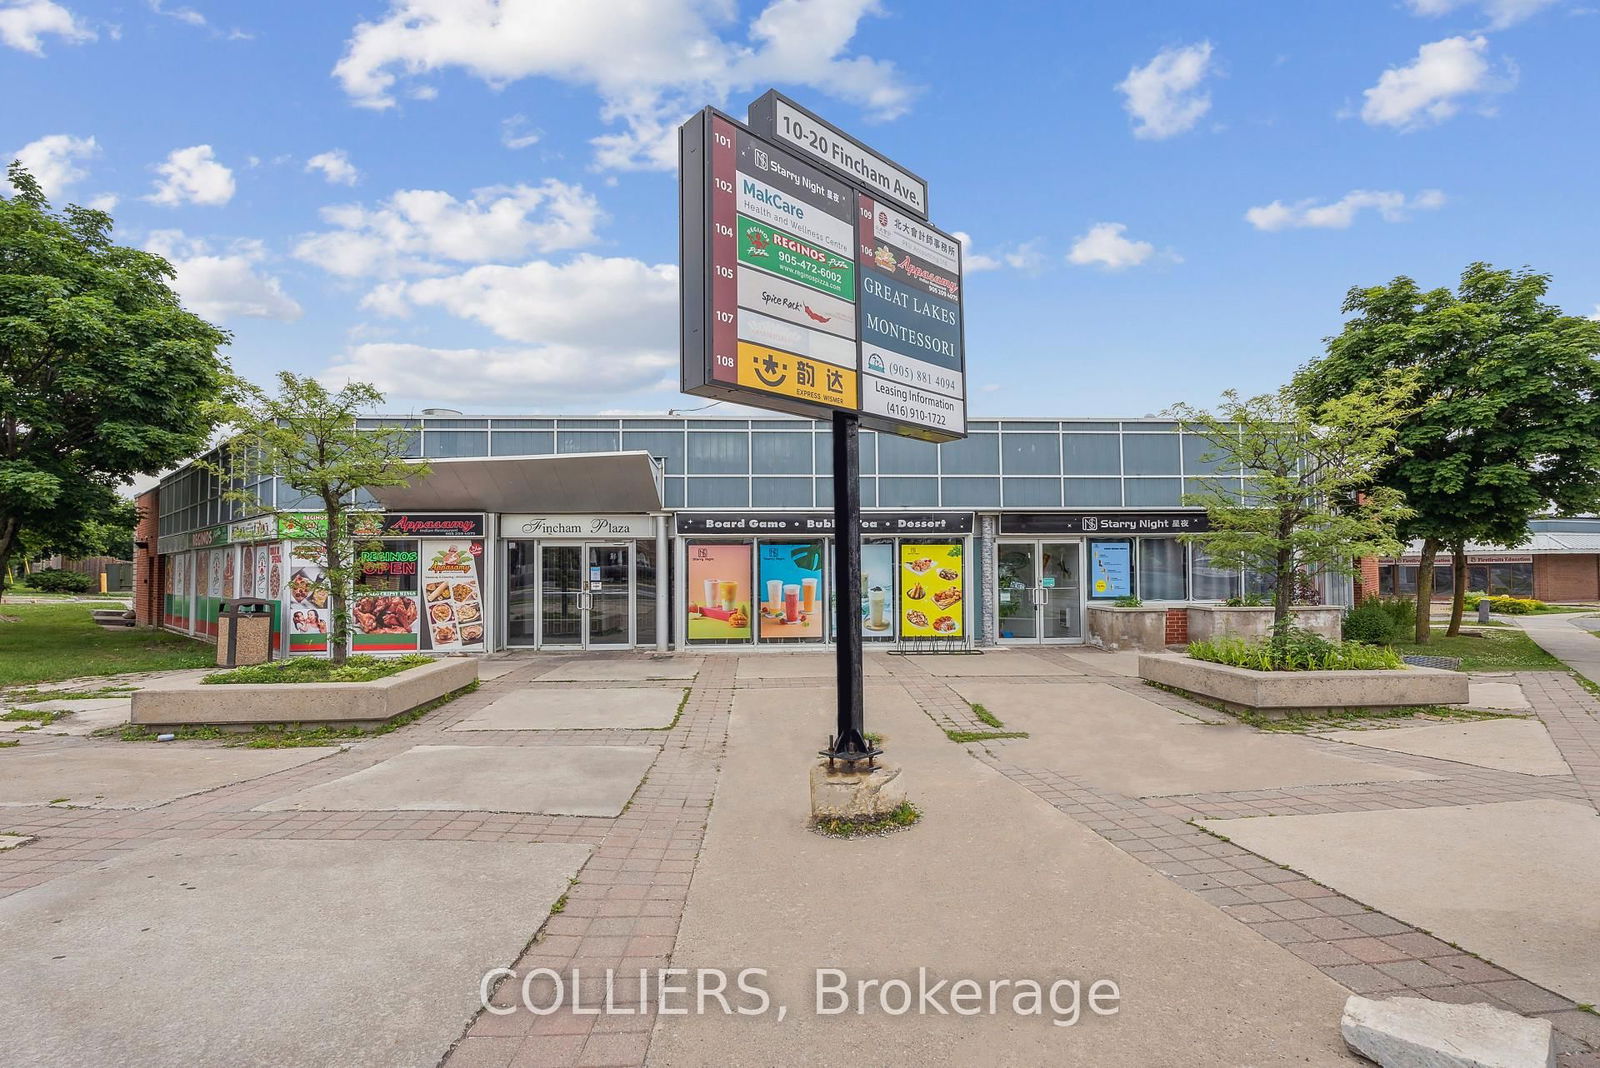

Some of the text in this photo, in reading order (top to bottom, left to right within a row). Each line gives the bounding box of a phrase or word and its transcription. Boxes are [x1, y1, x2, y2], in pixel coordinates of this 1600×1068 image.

[714, 132, 731, 149] 101
[783, 116, 920, 206] 10-20 Fincham Ave.
[715, 178, 733, 194] 102
[770, 160, 800, 185] Starry
[802, 175, 826, 198] Night
[743, 179, 804, 220] MakCare
[860, 207, 872, 220] 109
[715, 223, 733, 238] 104
[744, 200, 848, 252] Health and Wellness Centre
[773, 233, 826, 262] REGINOS
[861, 244, 873, 257] 106
[715, 265, 733, 279] 105
[779, 251, 842, 284] 905-472-6002
[898, 255, 958, 293] Appasamy
[779, 264, 841, 291] www.reginospizza.com
[761, 291, 781, 306] Spice
[864, 277, 908, 308] GREAT
[913, 297, 956, 326] LAKES
[716, 311, 733, 324] 107
[866, 313, 955, 357] MONTESSORI
[716, 355, 734, 368] 108
[889, 363, 955, 389] (905) 881 4094
[796, 389, 821, 400] EXPRESS
[875, 381, 954, 411] Leasing Information
[886, 402, 946, 426] (416) 910-1722
[391, 516, 476, 532] Appasamy
[522, 518, 630, 534] Fincham Plaza
[705, 519, 946, 528] Board Game Bub ea Dessert
[1100, 519, 1137, 530] Starry
[1139, 519, 1169, 529] Night
[1171, 520, 1189, 528] 星夜
[361, 551, 418, 562] REGINOS
[363, 561, 416, 575] OPEN
[428, 560, 471, 574] Appasamy
